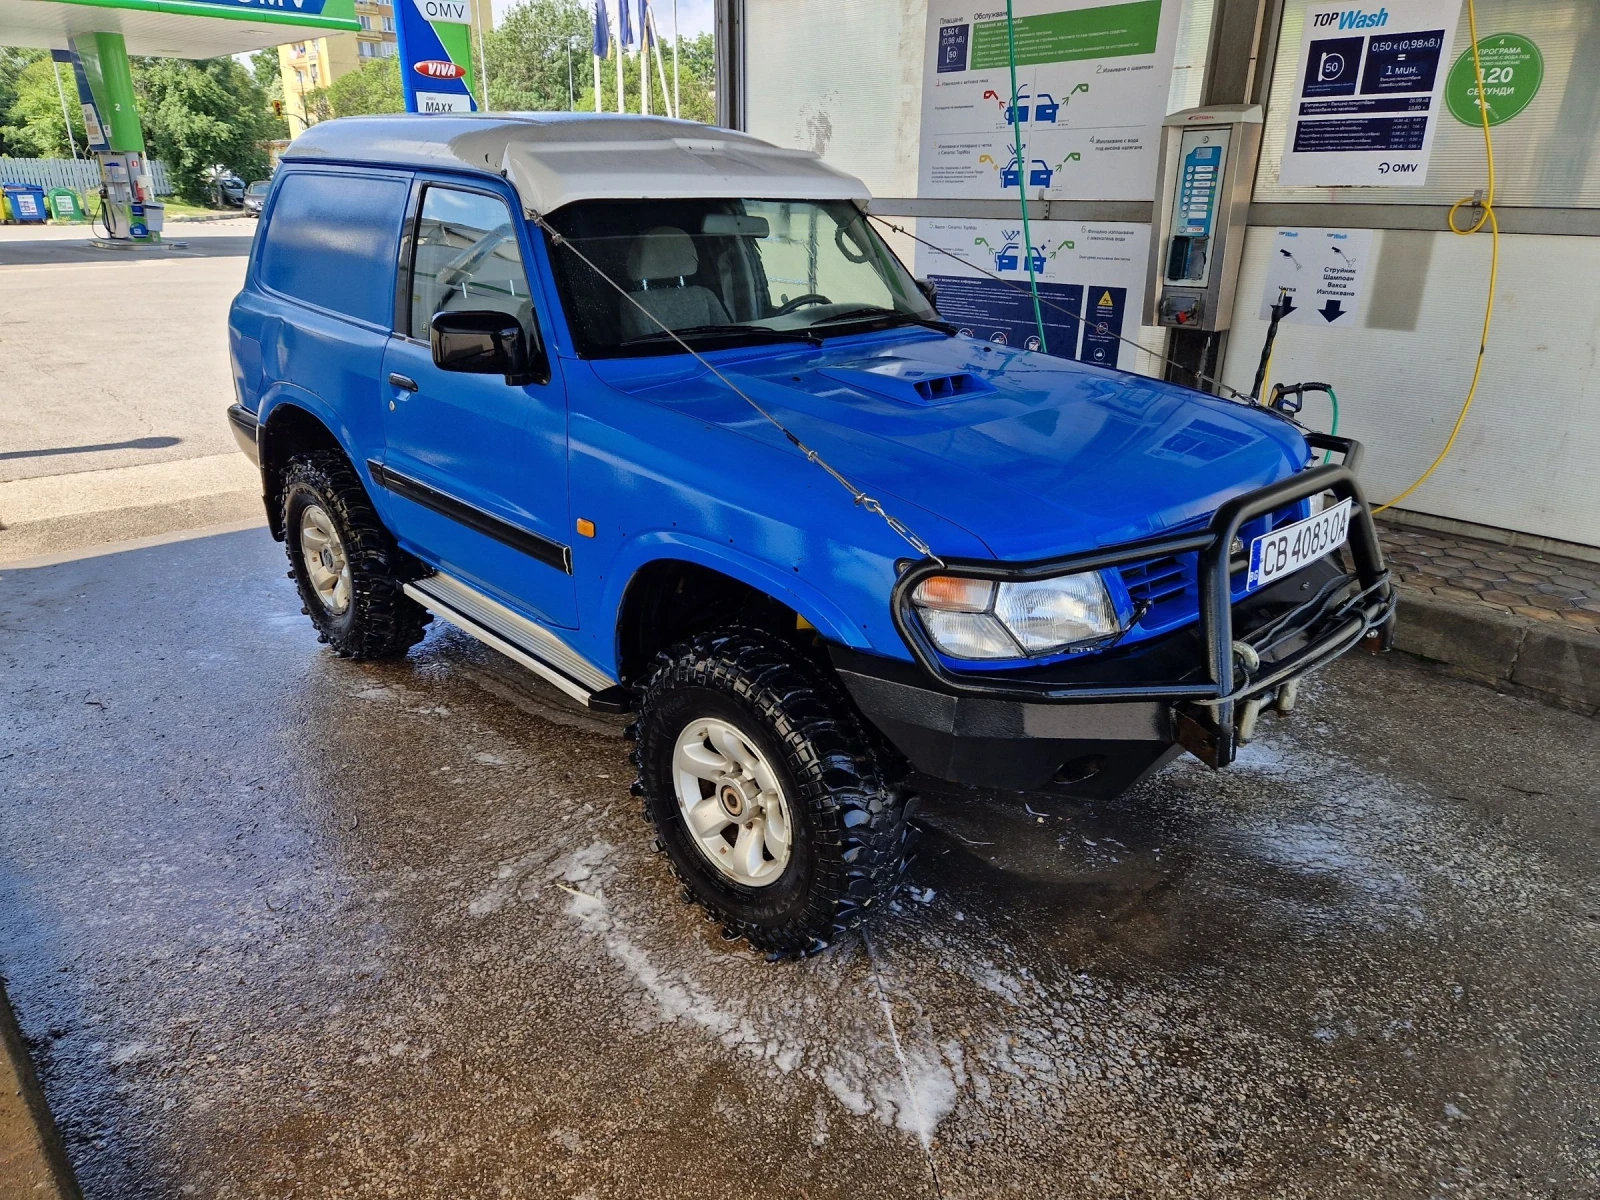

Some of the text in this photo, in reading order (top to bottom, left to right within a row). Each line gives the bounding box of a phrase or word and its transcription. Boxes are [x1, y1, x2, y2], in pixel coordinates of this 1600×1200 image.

[426, 1, 464, 18] OMV
[973, 10, 1009, 21] Обслужван
[1313, 8, 1389, 30] TOPWash
[1372, 41, 1392, 52] 0,50
[1478, 46, 1522, 55] ПРОГРАМА
[427, 62, 456, 77] VIVA
[1325, 62, 1339, 73] 50
[1385, 65, 1419, 75] 1 мин.
[1474, 66, 1514, 84] 120
[115, 103, 121, 111] 2
[425, 101, 453, 112] MAXX
[1392, 163, 1418, 172] OMV
[1323, 266, 1356, 275] Струйник
[1316, 288, 1355, 297] Изплакване
[1263, 535, 1288, 576] CB
[1291, 516, 1329, 563] 4083
